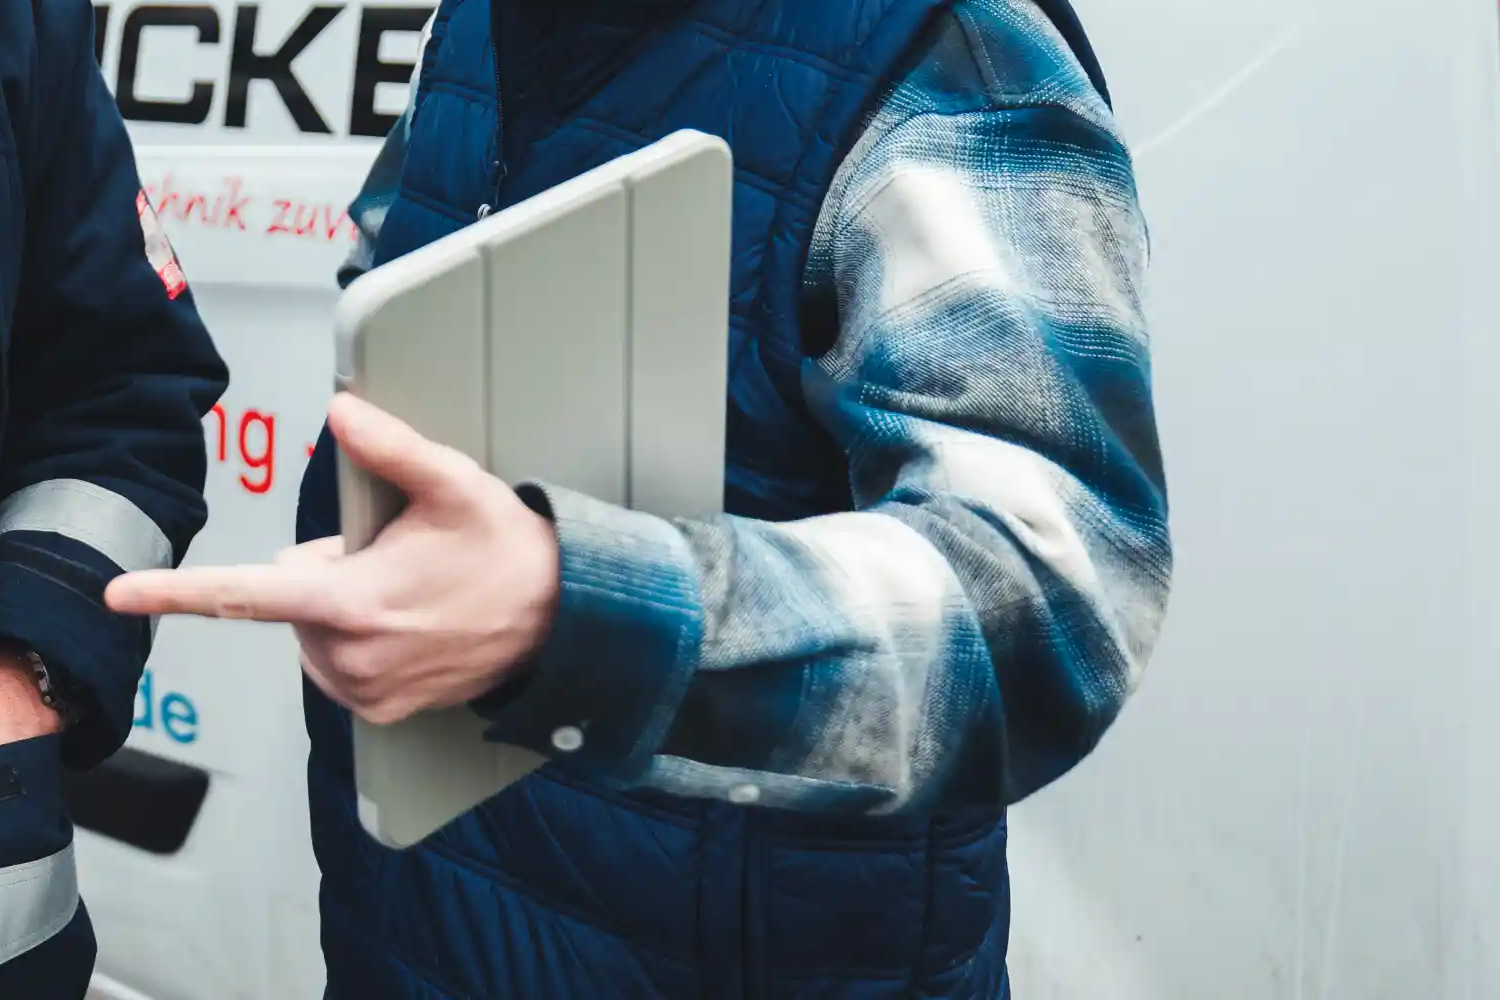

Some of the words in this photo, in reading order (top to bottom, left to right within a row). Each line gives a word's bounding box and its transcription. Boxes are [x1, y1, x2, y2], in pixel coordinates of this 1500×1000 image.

[266, 199, 359, 241] zuv
[210, 402, 275, 494] ng
[132, 667, 198, 744] de
